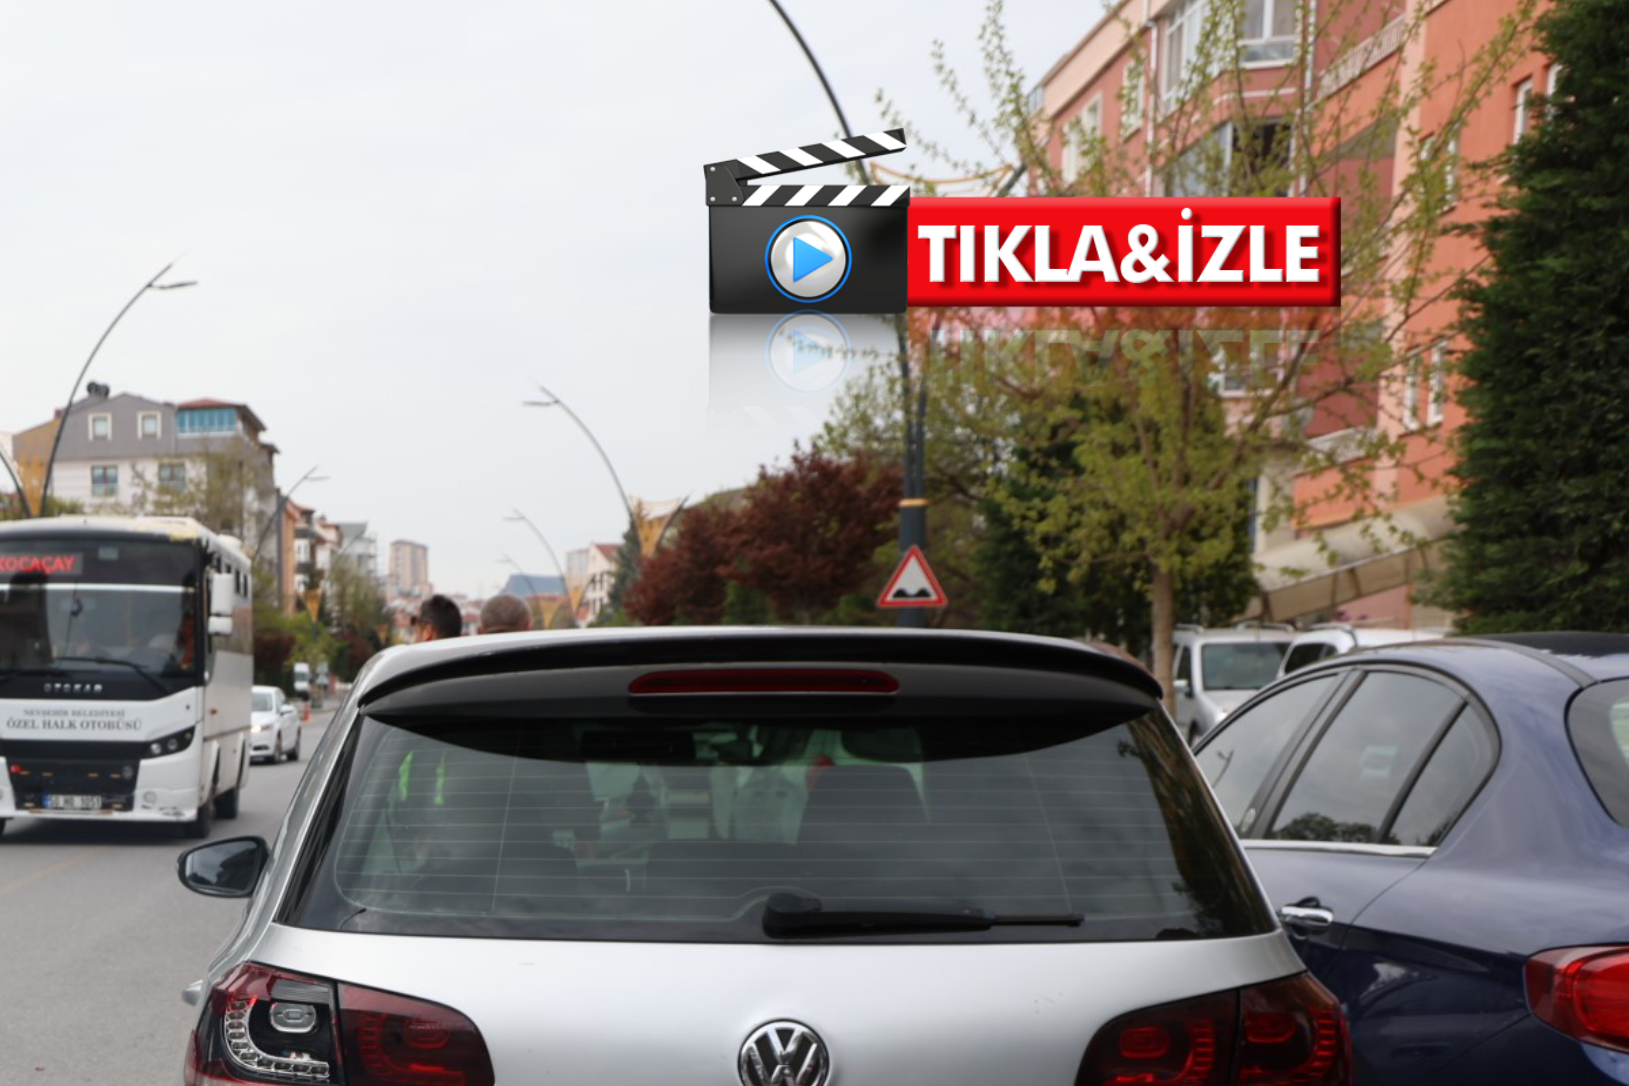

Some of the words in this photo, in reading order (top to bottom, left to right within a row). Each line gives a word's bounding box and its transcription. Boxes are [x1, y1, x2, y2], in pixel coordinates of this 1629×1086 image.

[44, 683, 103, 693] OTOKAR
[7, 716, 38, 730] ÖZEL
[42, 720, 77, 731] HALK
[80, 718, 142, 732] OTOBÜSÜ
